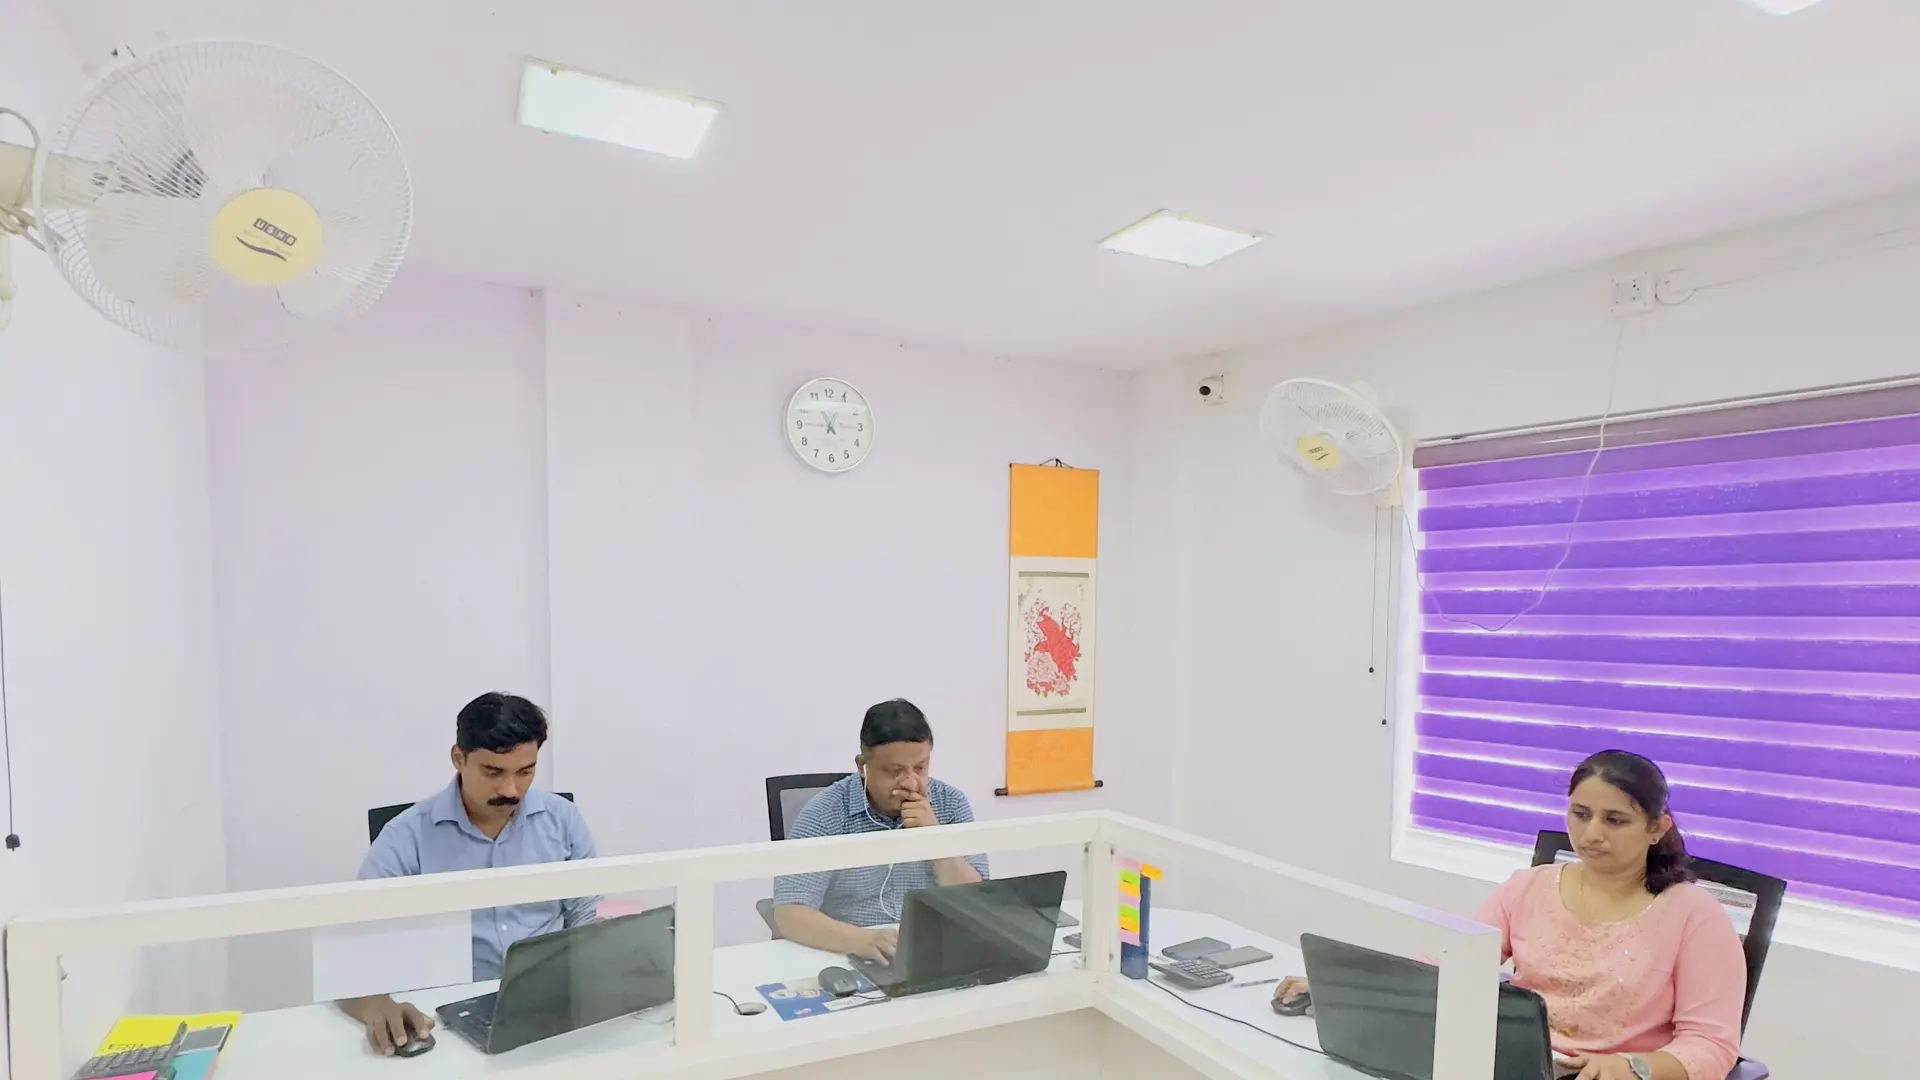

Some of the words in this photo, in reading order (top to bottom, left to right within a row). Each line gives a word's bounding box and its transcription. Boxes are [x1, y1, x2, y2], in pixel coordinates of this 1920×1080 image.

[254, 218, 297, 246] USHA
[809, 392, 819, 401] 11
[824, 388, 835, 398] 12
[852, 406, 859, 416] 2
[796, 420, 803, 430] 9
[857, 422, 863, 432] 3
[801, 436, 808, 446] 8
[853, 438, 860, 447] 4
[813, 448, 819, 458] 7
[828, 453, 835, 463] 6
[843, 449, 850, 459] 5
